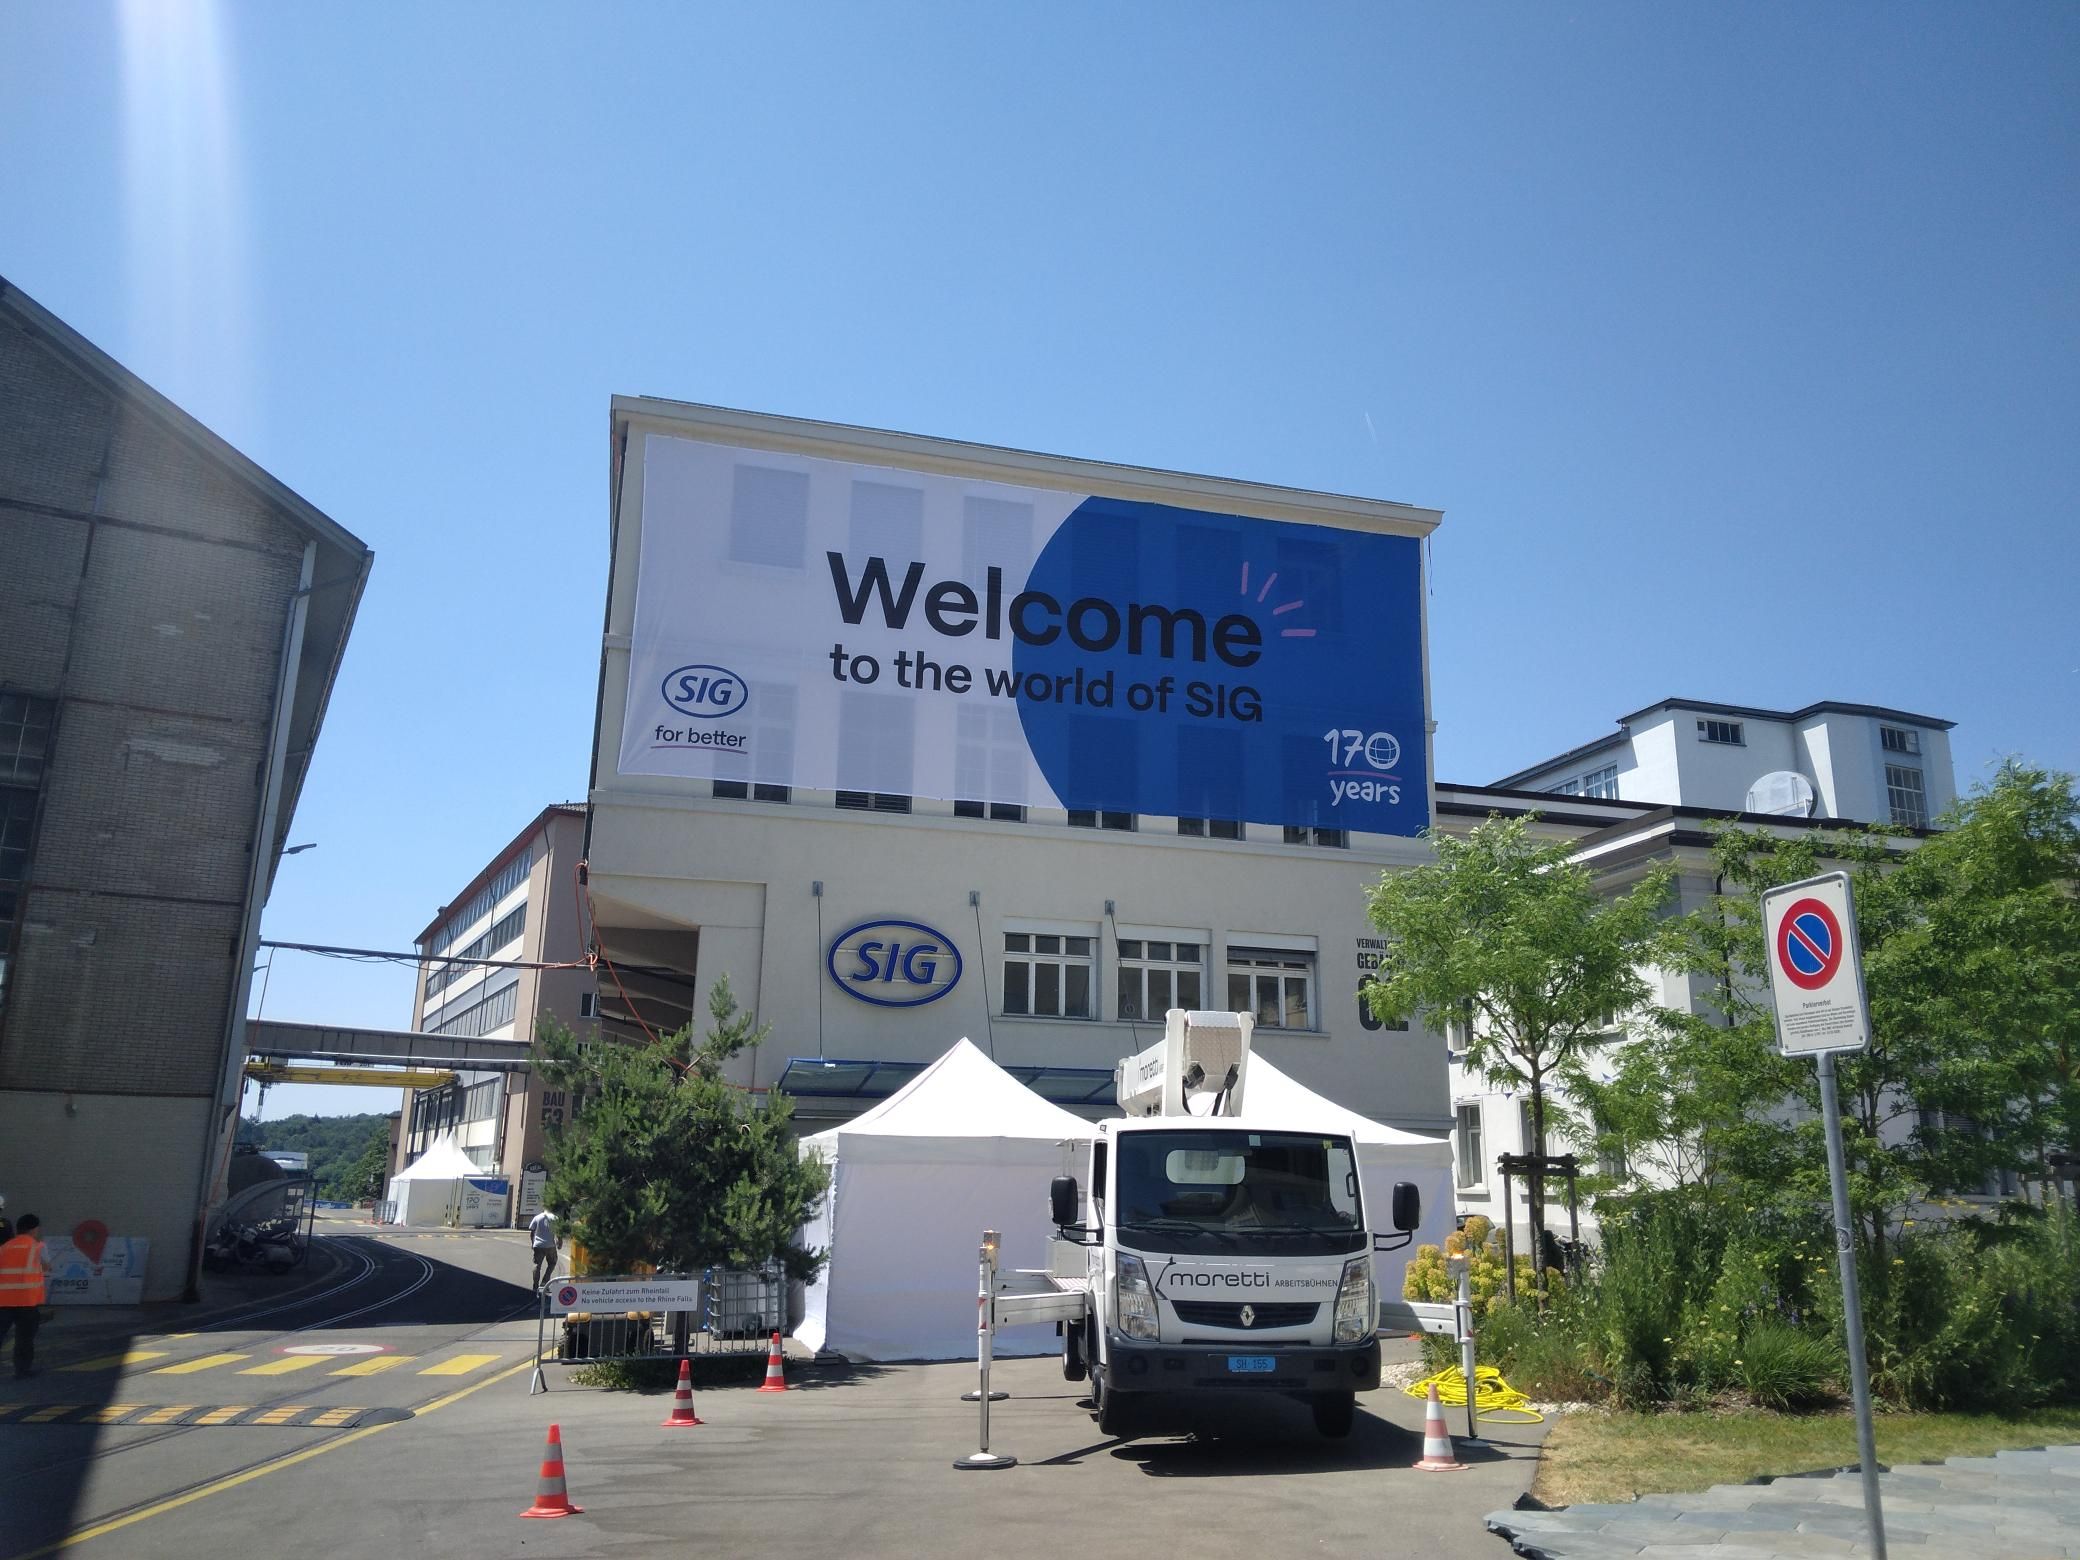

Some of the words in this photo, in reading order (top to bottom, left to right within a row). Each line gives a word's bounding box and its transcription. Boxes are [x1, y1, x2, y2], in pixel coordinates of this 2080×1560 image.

[826, 551, 1263, 668] Welcome
[674, 675, 733, 706] SIG
[829, 643, 881, 685] to
[893, 650, 973, 694] the
[984, 667, 1114, 708] world
[1126, 676, 1175, 713] of
[1185, 681, 1263, 723] SIG
[655, 725, 683, 742] for
[688, 727, 746, 747] better
[1323, 728, 1401, 770] 170
[1330, 779, 1401, 807] years
[851, 941, 939, 985] SIG
[543, 1091, 566, 1106] BAU
[641, 1287, 670, 1295] Rheinfall
[1170, 1271, 1271, 1288] moretti
[1275, 1278, 1338, 1288] ARBEITSBÜHNEN
[657, 1295, 676, 1303] Rhine
[1236, 1359, 1247, 1369] SH
[1252, 1359, 1268, 1369] 155
